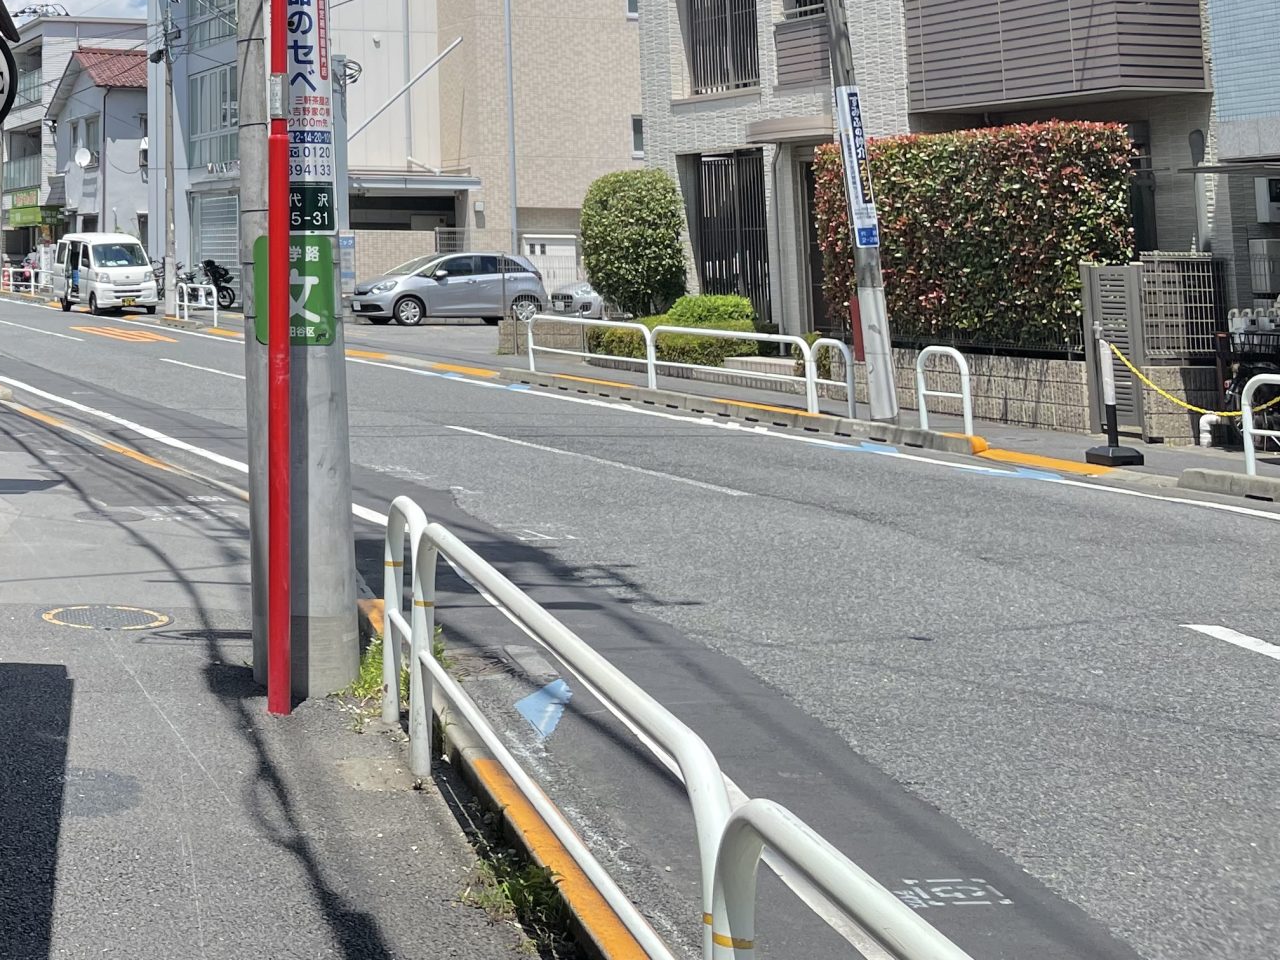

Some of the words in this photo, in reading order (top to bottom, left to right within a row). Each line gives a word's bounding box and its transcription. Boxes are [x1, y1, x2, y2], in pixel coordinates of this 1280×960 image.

[303, 146, 331, 158] 0120
[291, 211, 329, 225] 5-31
[289, 246, 320, 262] 学路
[289, 326, 315, 337] 田谷区
